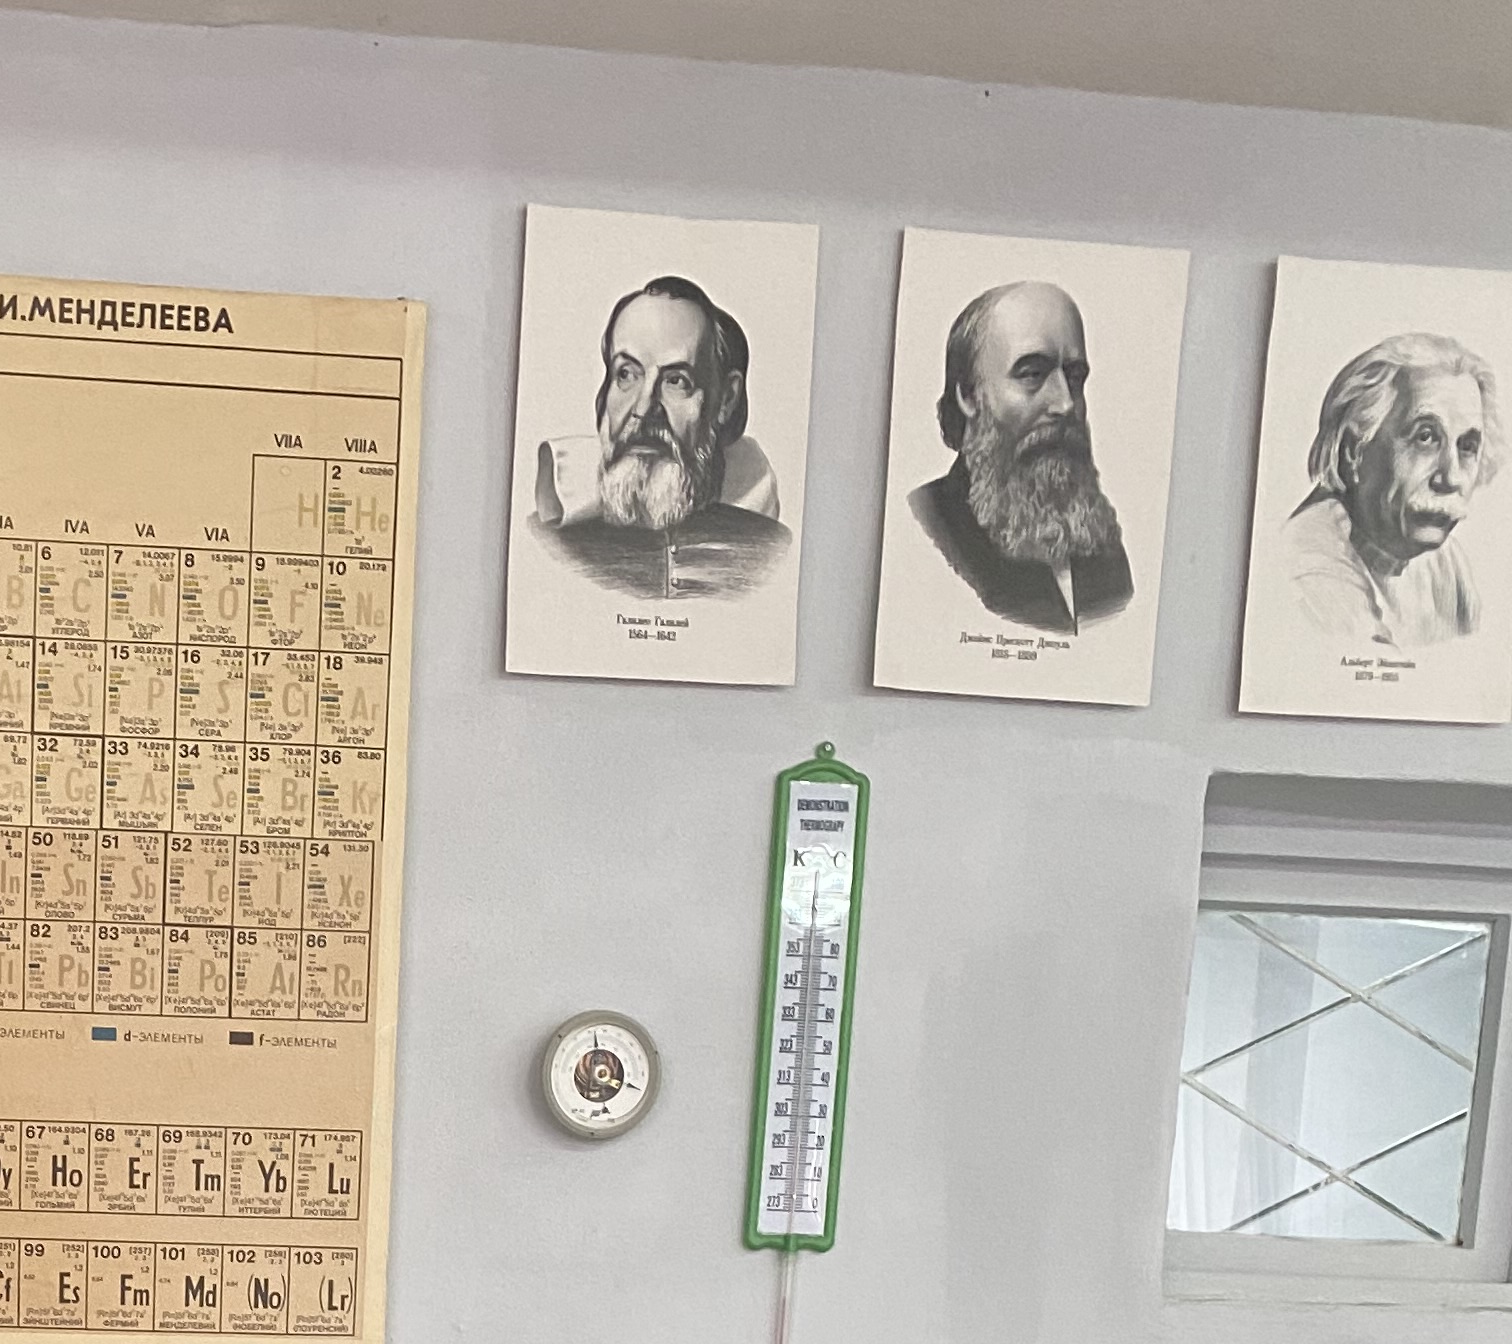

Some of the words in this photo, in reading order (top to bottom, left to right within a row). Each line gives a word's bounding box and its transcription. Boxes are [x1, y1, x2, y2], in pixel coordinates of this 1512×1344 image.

[273, 433, 304, 449] VIIA
[344, 438, 378, 454] VIIIA
[64, 519, 89, 535] IVA
[135, 522, 157, 539] VA
[203, 526, 230, 544] VIA
[793, 849, 806, 866] K
[834, 851, 846, 868] C
[784, 974, 797, 985] 343
[828, 975, 837, 987] 70
[123, 1030, 204, 1045] d-ЭЛЕМЕНТЫ
[259, 1034, 337, 1049] f-ЭЛЕМЕНТЫ
[823, 1040, 832, 1053] 50
[772, 1133, 785, 1145] 293
[51, 1155, 83, 1188] Ho
[128, 1158, 152, 1190] Er
[192, 1160, 221, 1192] Tm
[257, 1160, 287, 1193] Yb
[327, 1162, 351, 1195] Lu
[814, 1167, 822, 1178] 10
[767, 1196, 780, 1207] 273
[813, 1198, 818, 1209] 0
[59, 1272, 80, 1304] Es
[120, 1274, 150, 1307] Fm
[185, 1276, 217, 1308] Md
[247, 1272, 286, 1312] (No)
[319, 1275, 353, 1315] (Lr)
